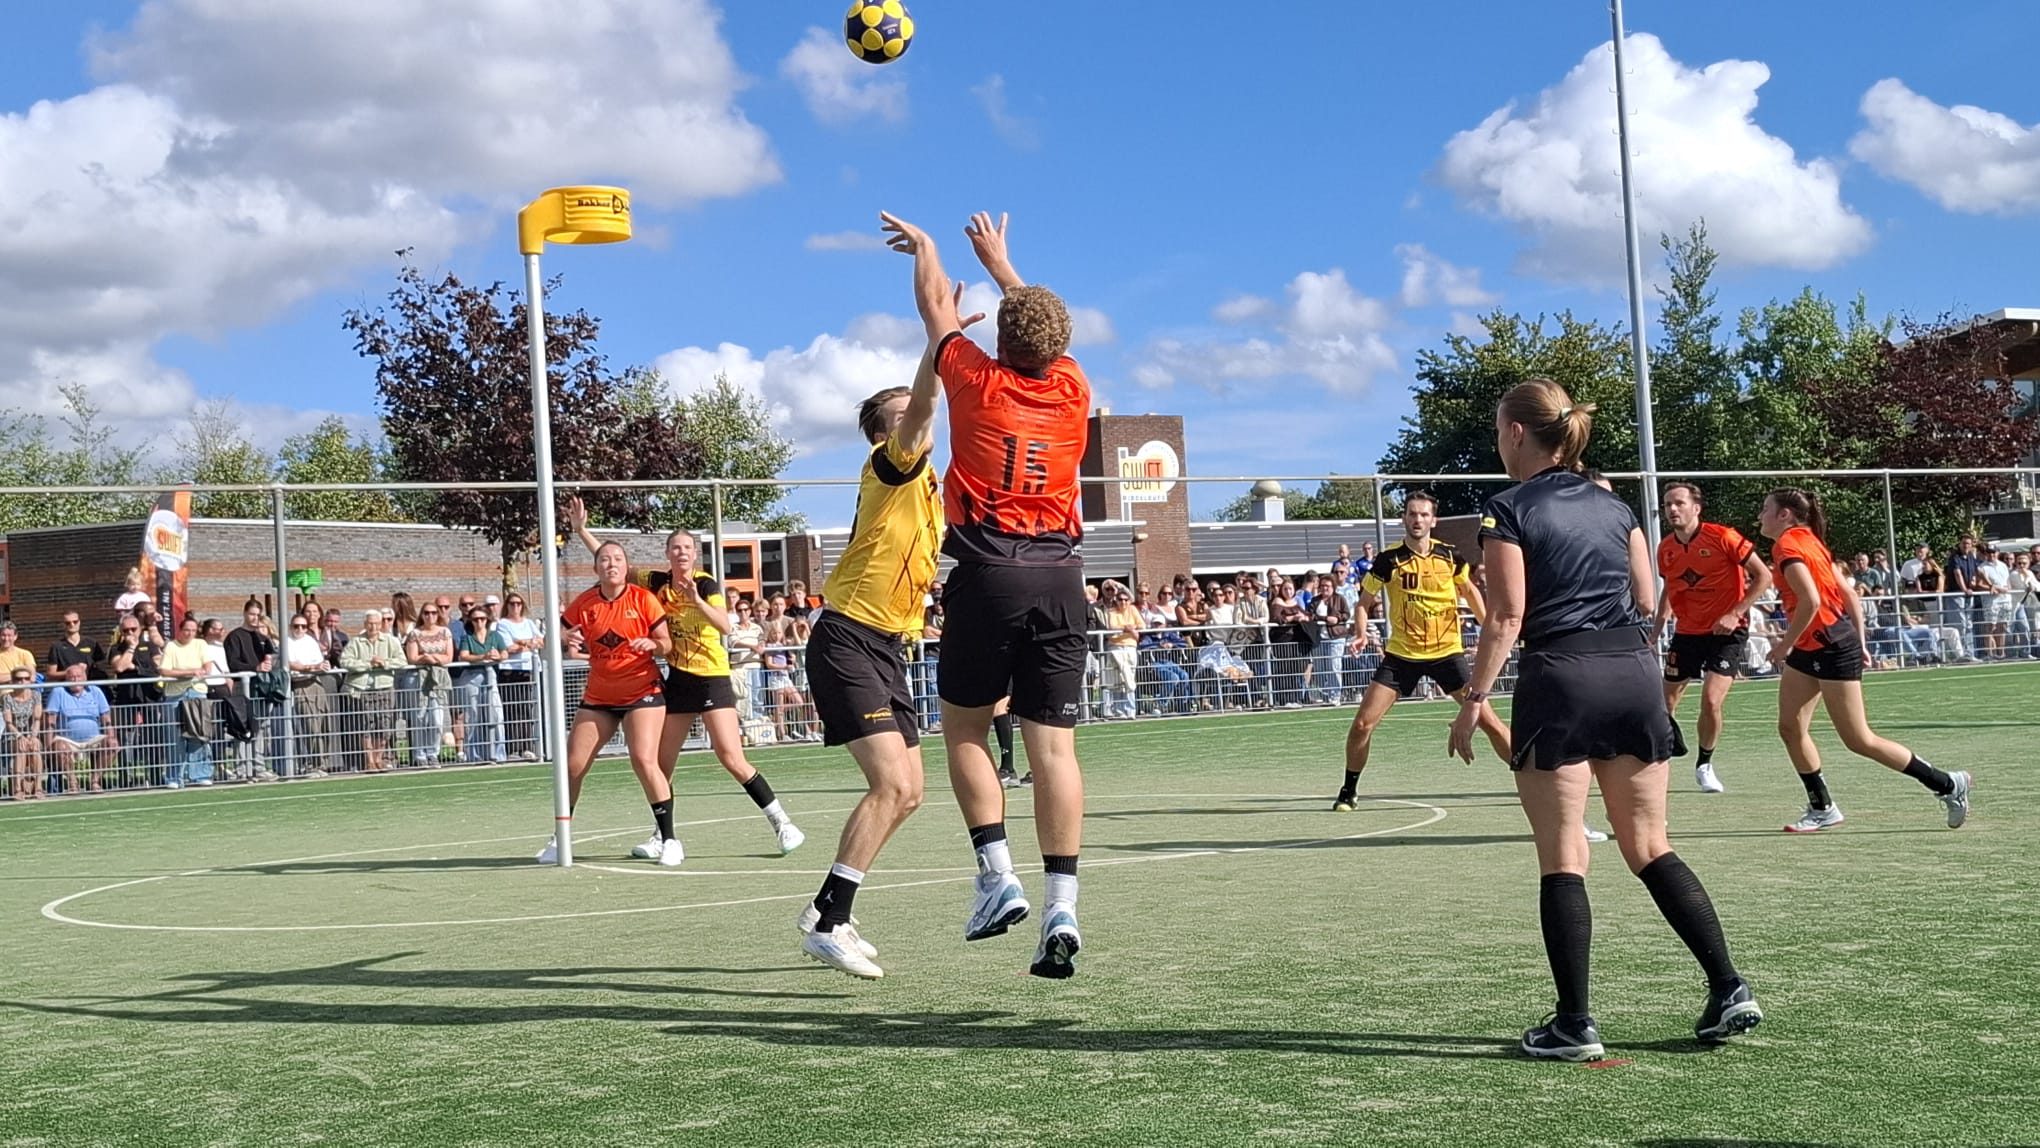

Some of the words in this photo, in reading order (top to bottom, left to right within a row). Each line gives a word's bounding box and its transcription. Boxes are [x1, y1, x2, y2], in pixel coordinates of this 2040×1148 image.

[1001, 436, 1049, 495] 15
[1122, 462, 1162, 490] SWIFT
[157, 528, 181, 555] SWIFT
[1400, 572, 1418, 590] 10
